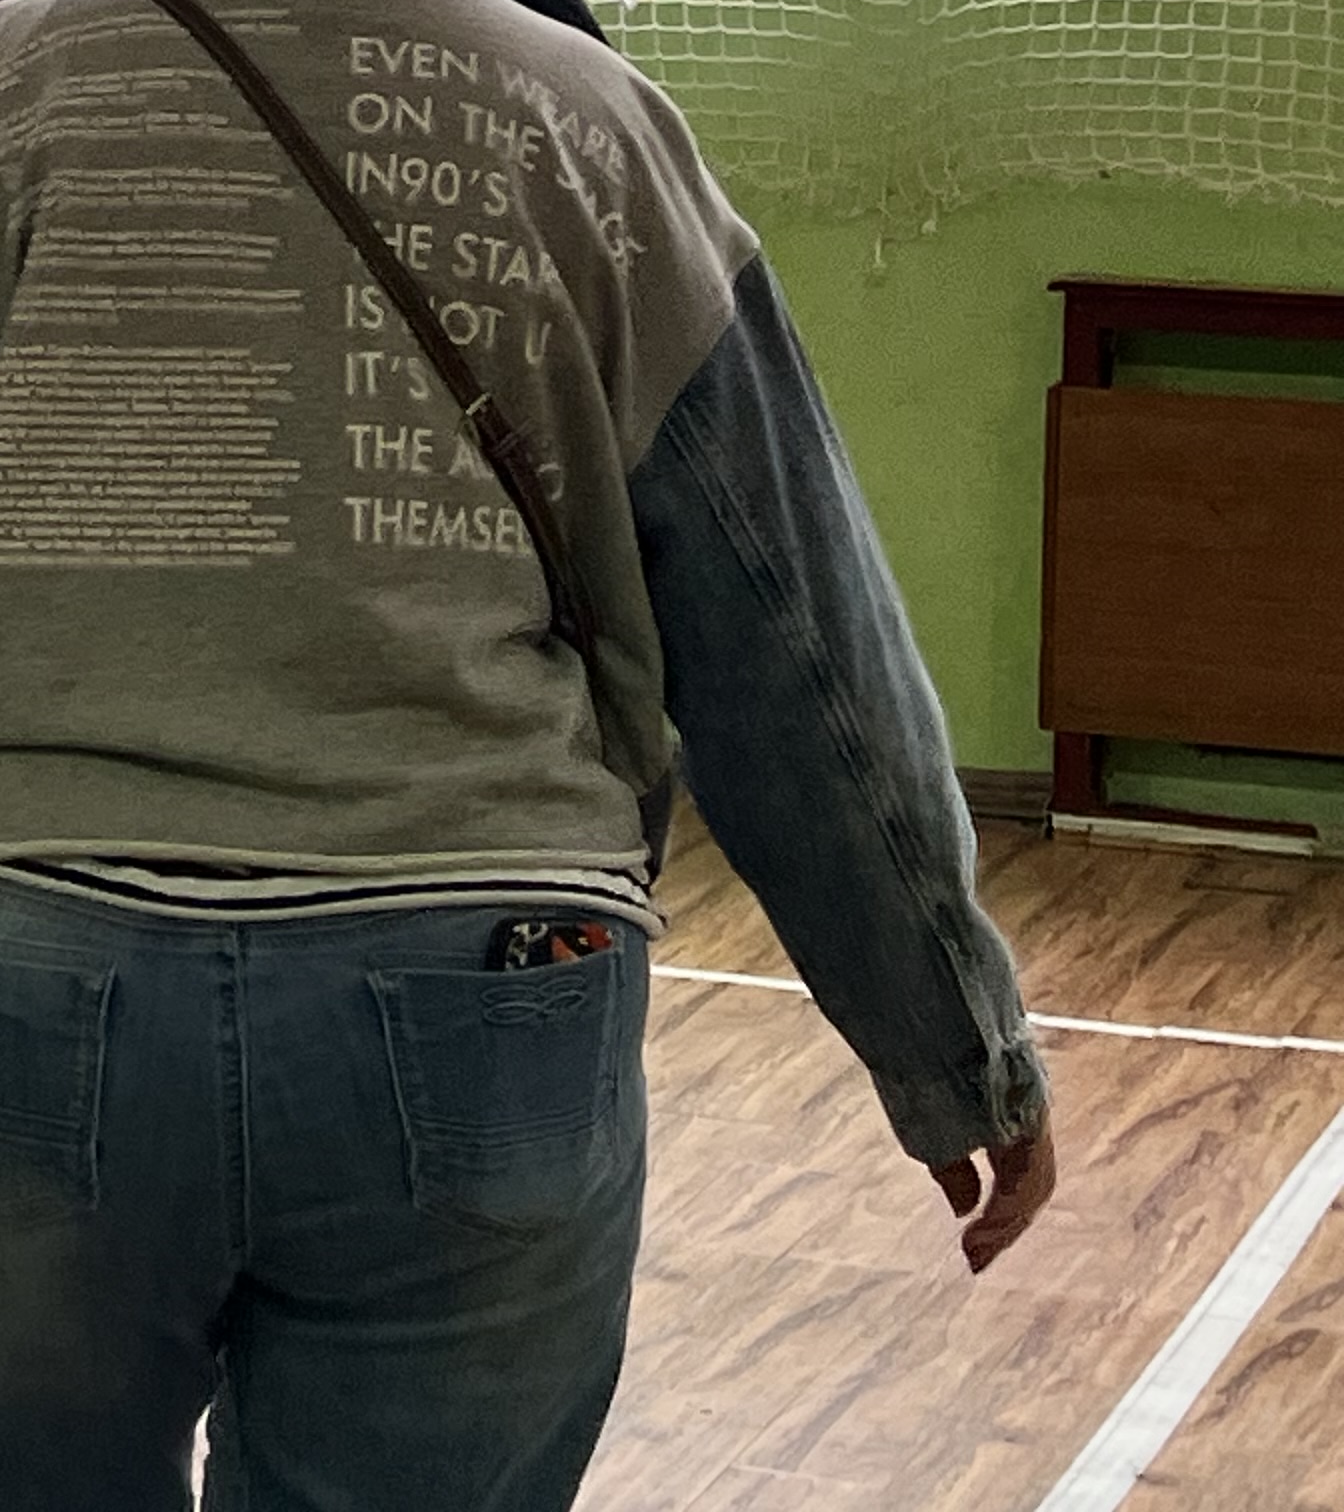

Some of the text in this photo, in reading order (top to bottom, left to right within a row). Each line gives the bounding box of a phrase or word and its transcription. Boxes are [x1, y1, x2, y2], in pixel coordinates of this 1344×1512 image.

[350, 37, 479, 83] EVEN
[348, 93, 545, 172] ON THE
[354, 220, 433, 271] HE
[345, 284, 385, 330] IS
[416, 296, 508, 350] OT
[346, 351, 428, 400] IT'S
[346, 424, 433, 474] THE
